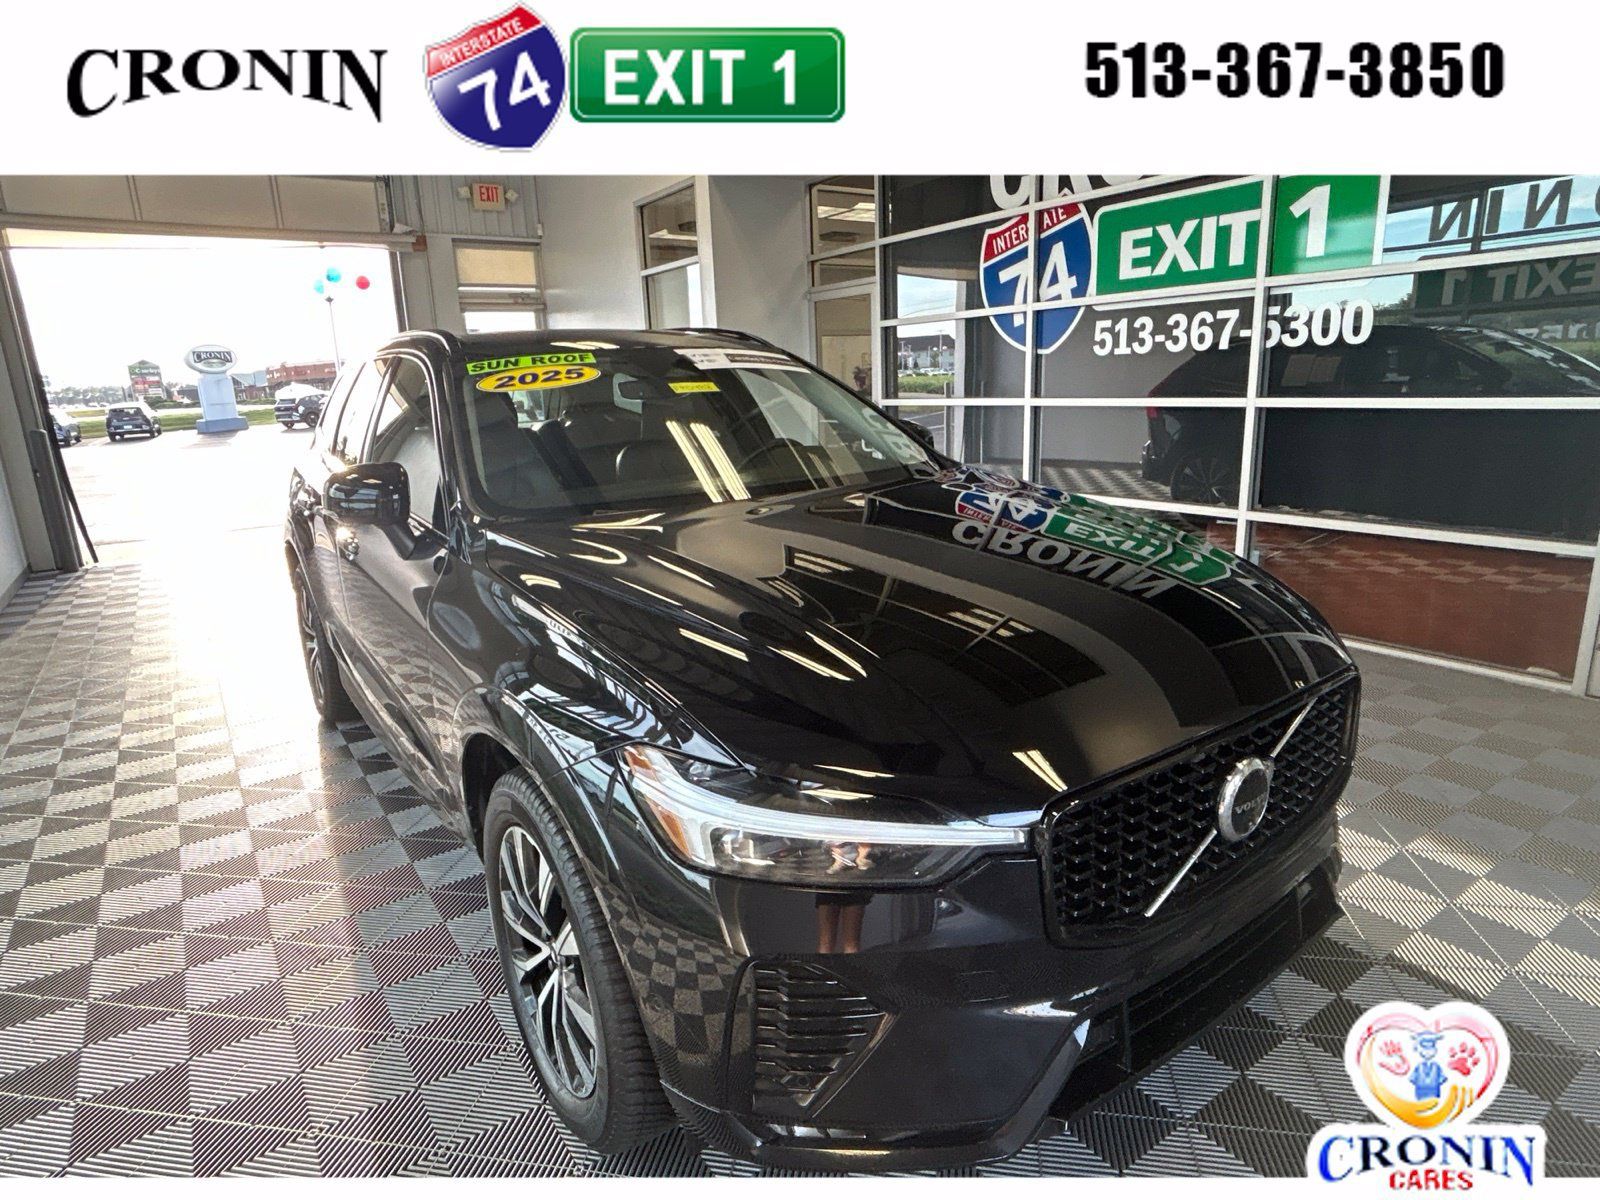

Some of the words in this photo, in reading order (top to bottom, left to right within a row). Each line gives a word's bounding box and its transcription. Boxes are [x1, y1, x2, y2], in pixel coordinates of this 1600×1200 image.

[479, 185, 499, 203] EXIT
[1118, 208, 1262, 281] EXIT
[1289, 184, 1331, 258] 1
[998, 240, 1078, 328] 74
[1092, 300, 1375, 357] 513-367-5300
[193, 351, 232, 362] CRONIN
[470, 358, 520, 373] SUN
[530, 353, 592, 366] ROOF
[493, 367, 585, 390] 2025
